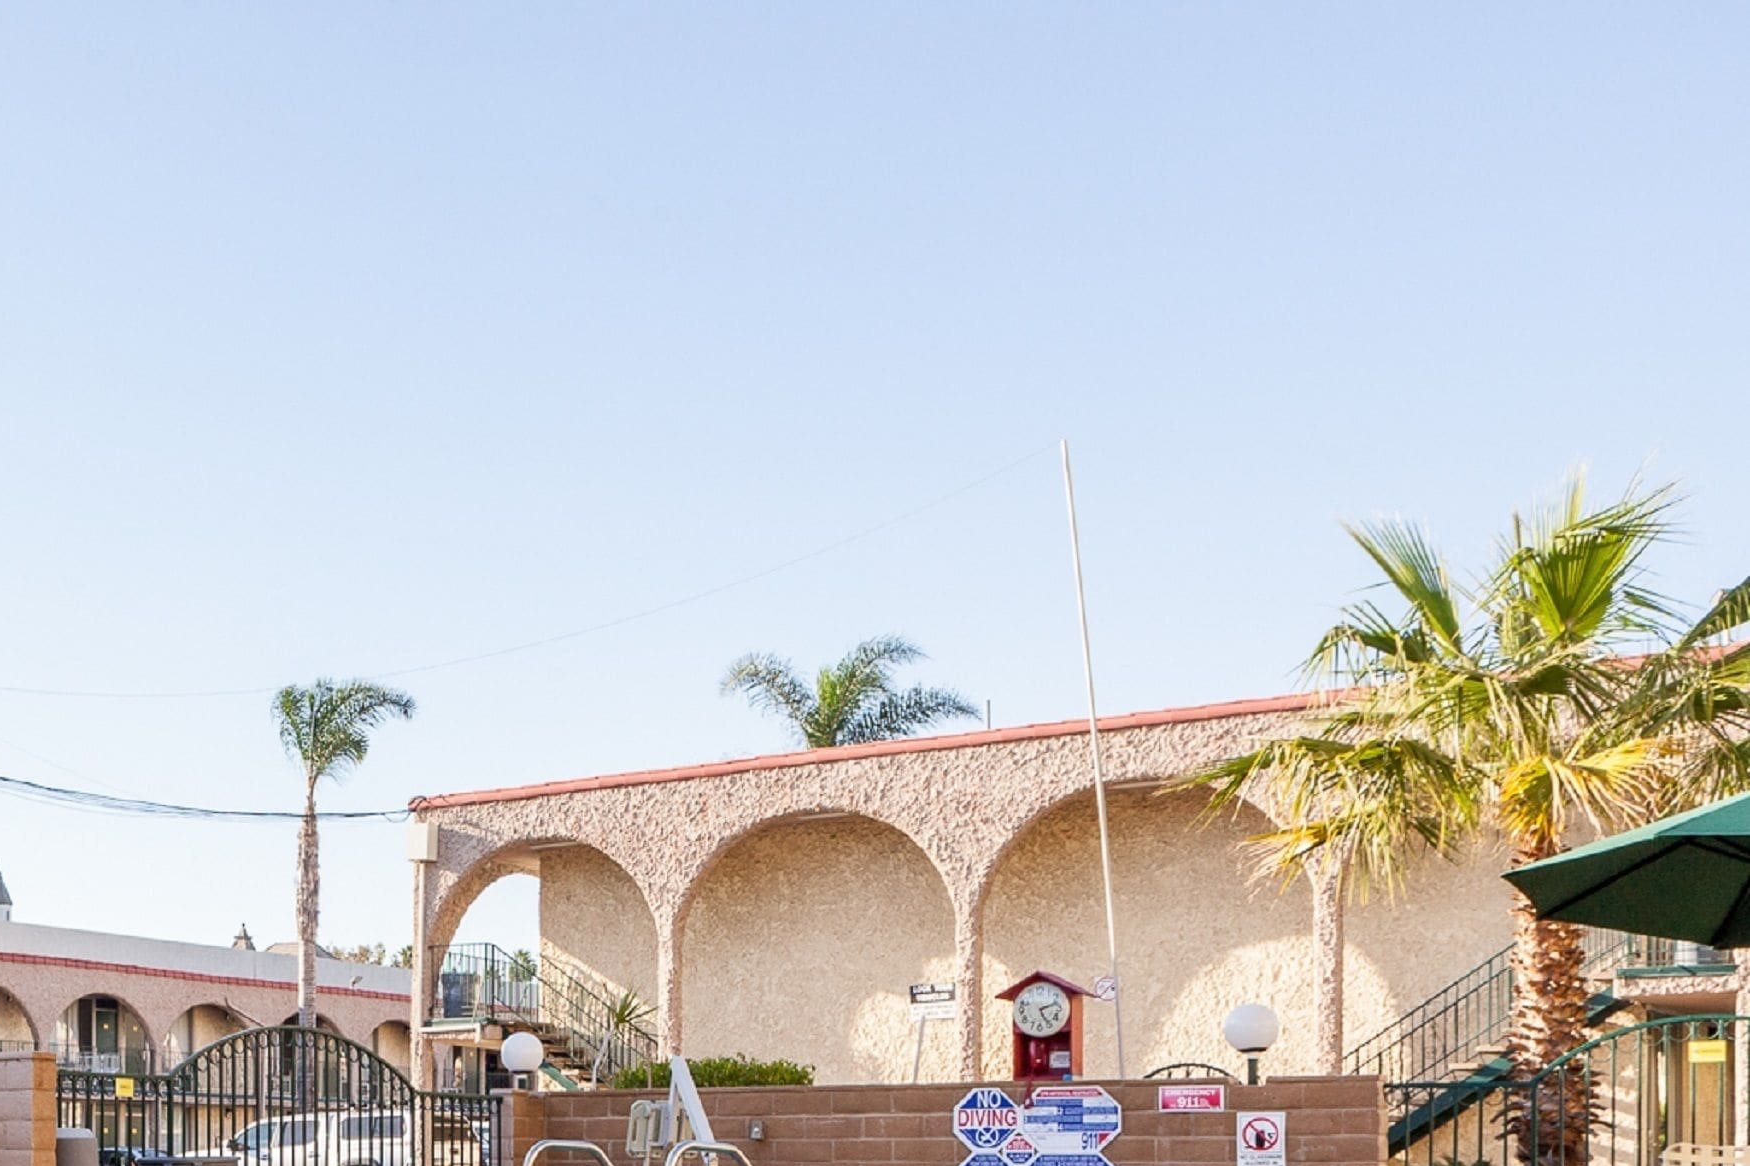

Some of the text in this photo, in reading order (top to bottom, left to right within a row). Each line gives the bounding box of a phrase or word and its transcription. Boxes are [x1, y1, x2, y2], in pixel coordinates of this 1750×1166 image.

[977, 1090, 1001, 1108] NO
[1176, 1096, 1199, 1108] 911
[958, 1109, 1018, 1127] DIVING
[1081, 1132, 1098, 1151] 911
